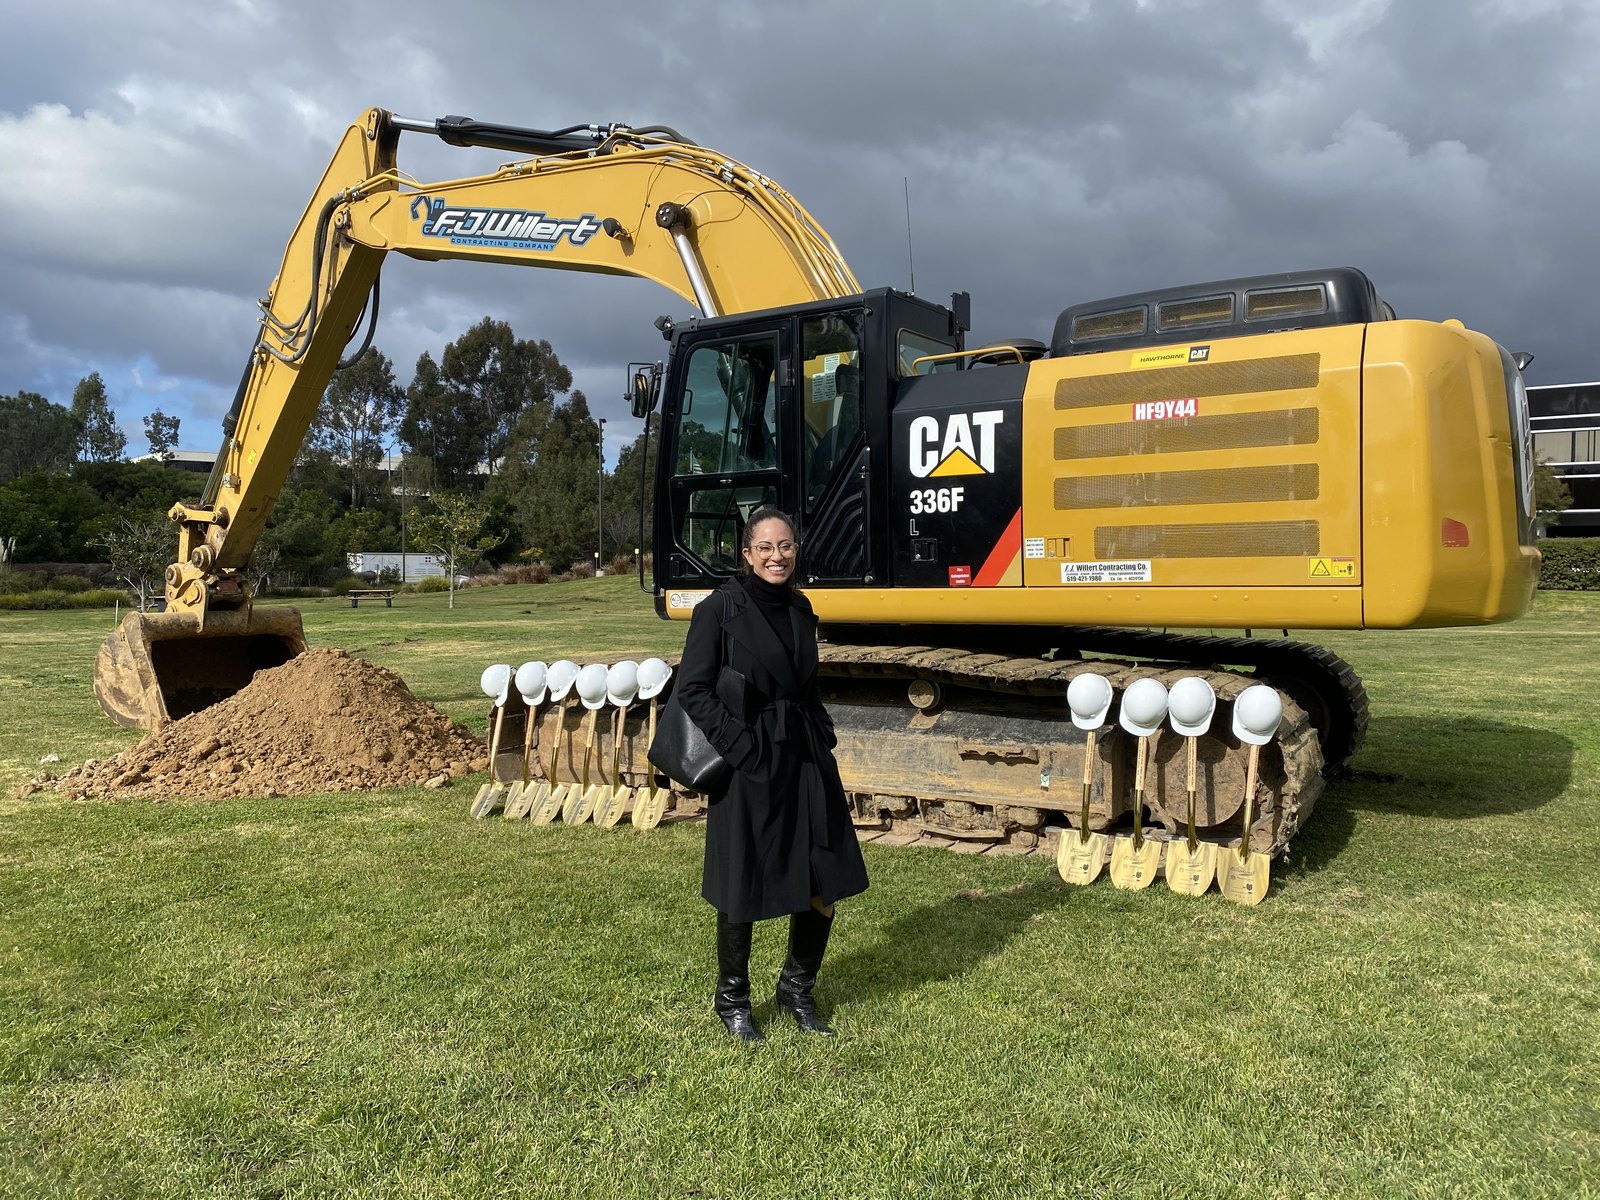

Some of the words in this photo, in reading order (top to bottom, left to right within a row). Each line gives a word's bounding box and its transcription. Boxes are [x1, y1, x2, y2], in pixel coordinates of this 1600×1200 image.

[451, 237, 509, 248] CONTRACTING
[513, 241, 555, 251] COMPANY
[1139, 353, 1186, 363] HAWTHORNE
[1190, 349, 1209, 360] CAT
[1135, 399, 1196, 420] HF9Y44
[909, 410, 1004, 478] CAT
[910, 487, 964, 514] 336F
[909, 518, 920, 536] L
[1076, 564, 1098, 572] Willert
[1098, 563, 1137, 571] Contracting
[1137, 562, 1148, 570] Co.
